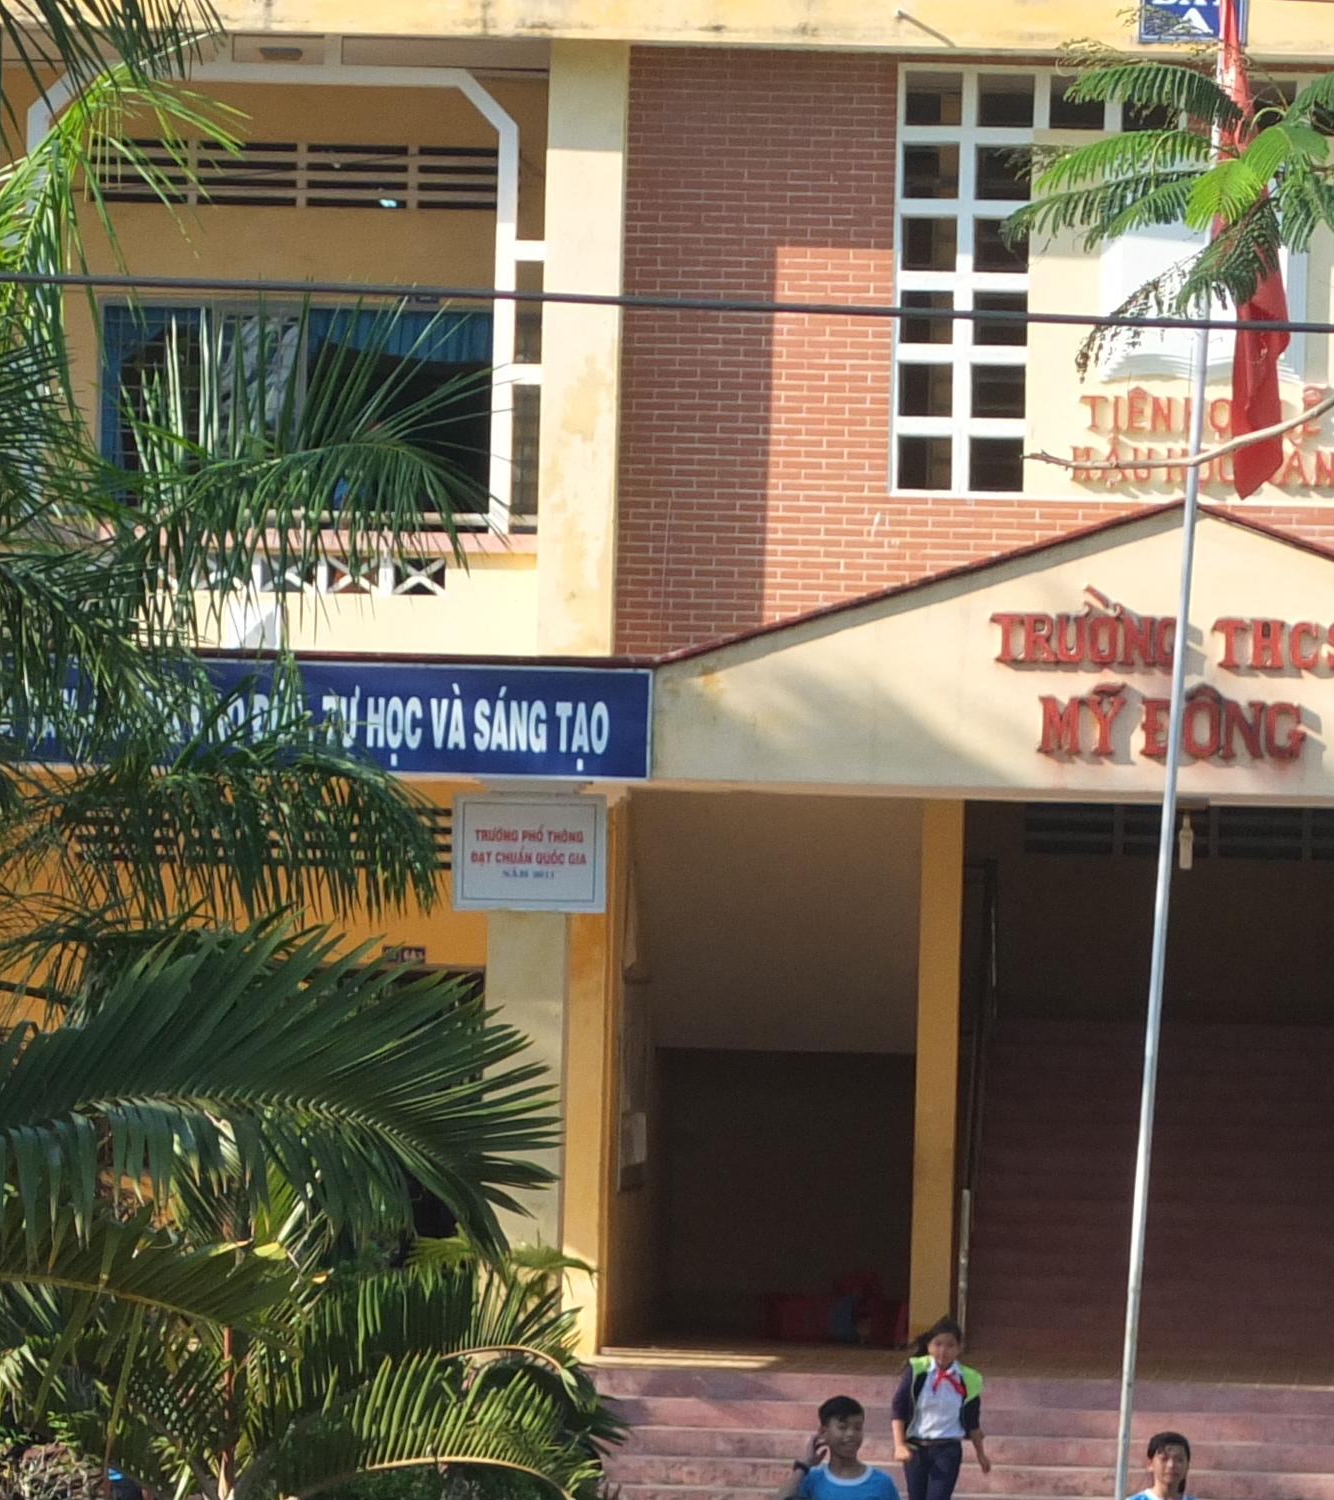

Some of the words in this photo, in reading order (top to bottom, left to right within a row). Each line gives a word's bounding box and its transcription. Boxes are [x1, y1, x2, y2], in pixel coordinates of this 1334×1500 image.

[989, 584, 1182, 667] TRƯỜNG
[366, 695, 423, 768] HỌC
[430, 683, 467, 751] VÀ
[473, 685, 548, 754] SÁNG
[555, 700, 610, 772] TẠO
[1037, 682, 1128, 756] MỸ
[470, 851, 493, 868] ĐẠT
[495, 846, 533, 865] CHUẨN
[535, 849, 566, 866] QUỐC
[568, 852, 588, 866] GIA
[474, 826, 519, 843] TRƯỜNG
[521, 823, 544, 843] PHỔ
[548, 827, 585, 844] THÔNG
